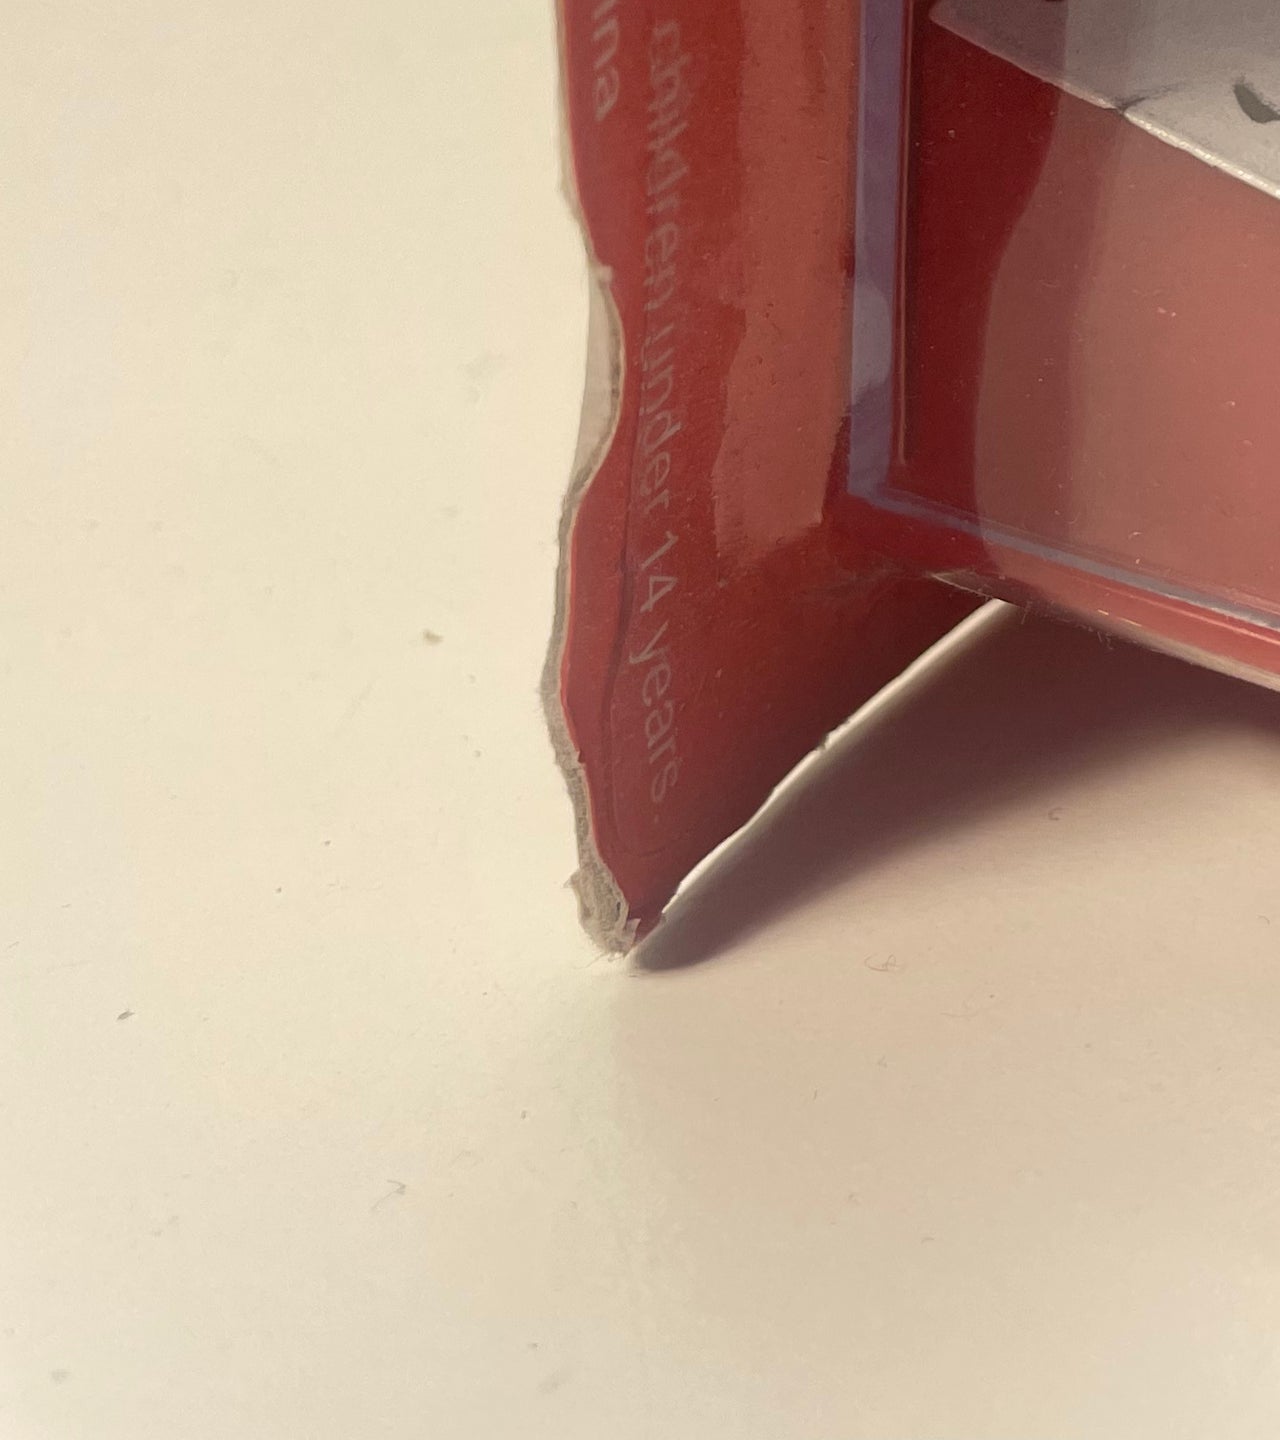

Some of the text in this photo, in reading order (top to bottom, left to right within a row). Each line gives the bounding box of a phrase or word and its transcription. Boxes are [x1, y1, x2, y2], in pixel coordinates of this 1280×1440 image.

[643, 20, 692, 311] children
[637, 322, 683, 516] under
[640, 530, 679, 613] 14
